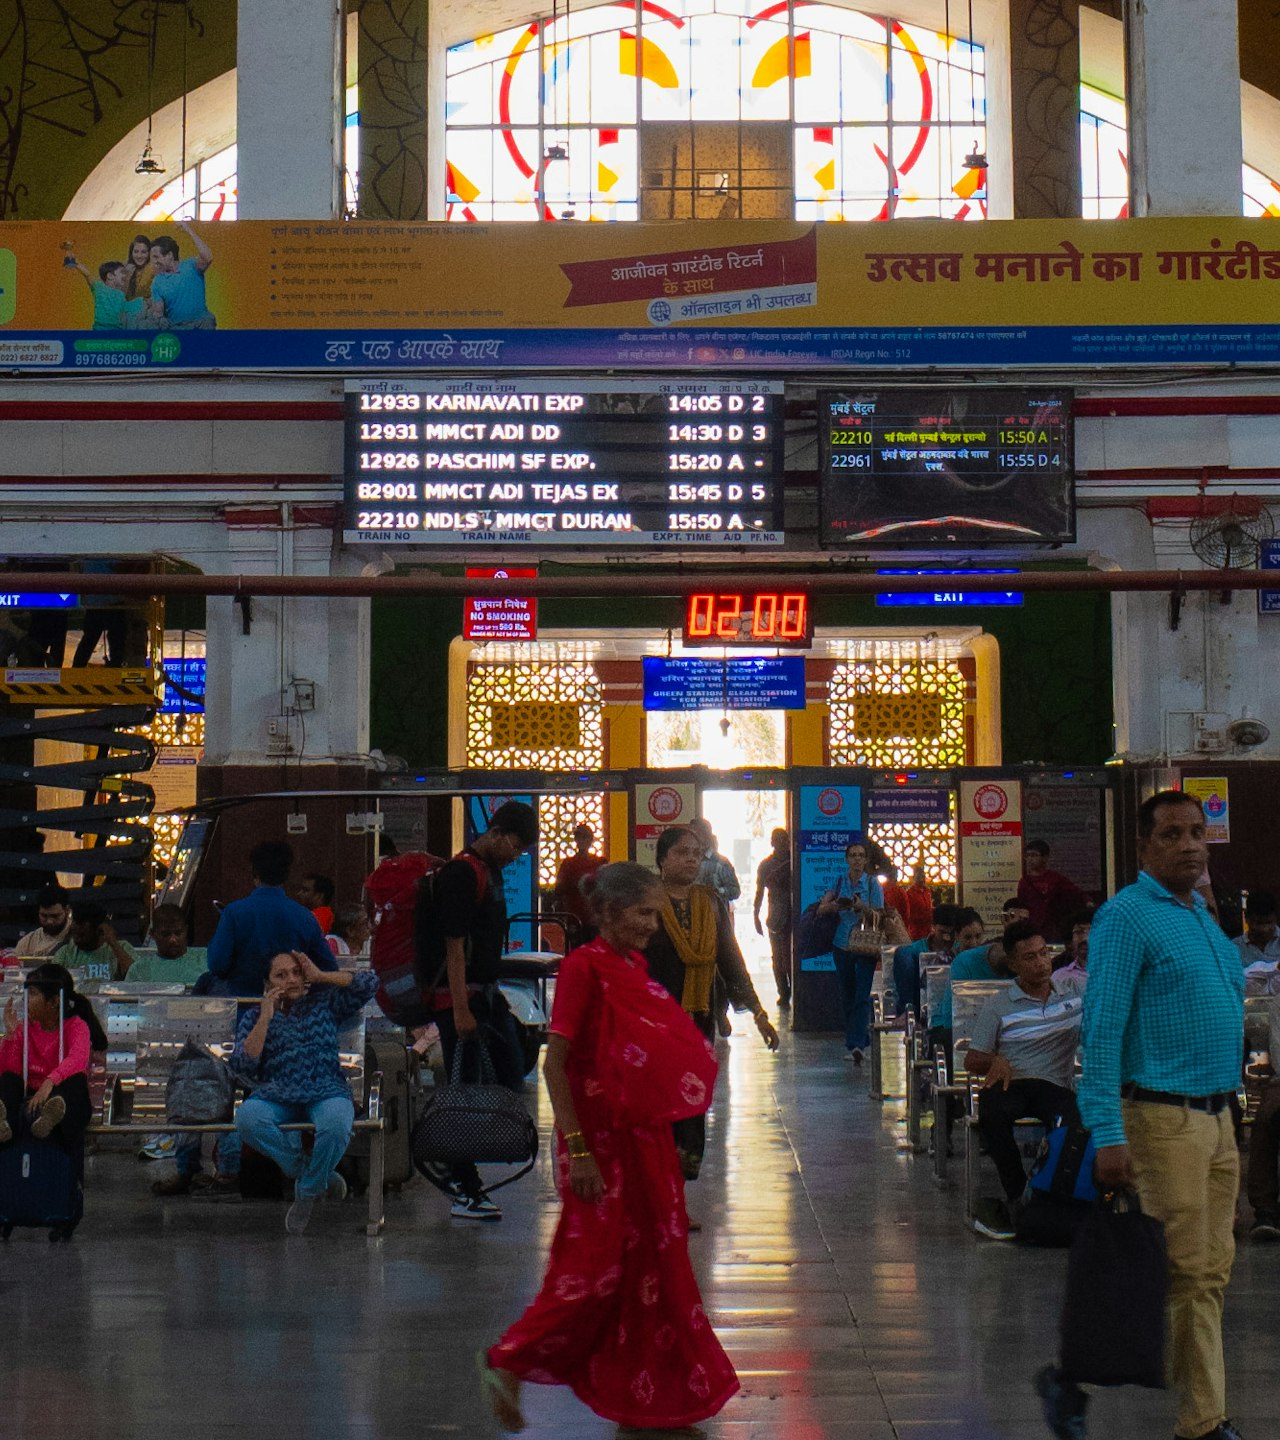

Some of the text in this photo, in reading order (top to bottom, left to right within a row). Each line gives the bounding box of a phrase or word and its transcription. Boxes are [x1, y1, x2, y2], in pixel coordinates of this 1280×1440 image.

[611, 249, 764, 281] आजीवन गारंटीड रिटर्न
[865, 253, 963, 283] उत्सव
[974, 241, 1084, 282] मनाने
[1092, 252, 1142, 281] का
[663, 277, 715, 295] के साथ
[681, 291, 812, 316] ऑनलाइन भी उपलब्ध
[325, 333, 504, 361] हर पल आपके साथ
[765, 349, 786, 358] India
[19, 353, 37, 362] 6827
[75, 353, 146, 365] 8976862090
[831, 350, 911, 360] IRDAI Regn 512
[360, 394, 764, 411] 12933 KARNAVATI EXP 14:05 D 2
[830, 401, 876, 415] मुंबई सेंट्रल
[360, 423, 766, 440] 12931 MMCT ADI DD 14:30 D 3
[831, 431, 1047, 445] 22210 15:50 A
[360, 453, 744, 470] 12926 PASCHIM SF EXP. 15:20 A
[831, 454, 1061, 467] 22961 15:55 D 4
[358, 483, 765, 504] 82901 MMCT ADI TEJAS EX 15:45 D 5
[358, 513, 744, 530] 22210 NDLS MMCT DURAN 15:50 A
[359, 532, 391, 541] TRAIN
[394, 532, 410, 541] NO
[462, 532, 495, 541] TRAIN
[499, 532, 531, 541] NAME
[653, 532, 682, 541] EXPT.
[687, 532, 712, 541] TIME
[724, 532, 741, 541] A/D
[933, 592, 965, 602] EXIT
[470, 611, 531, 621] NO SMOKING
